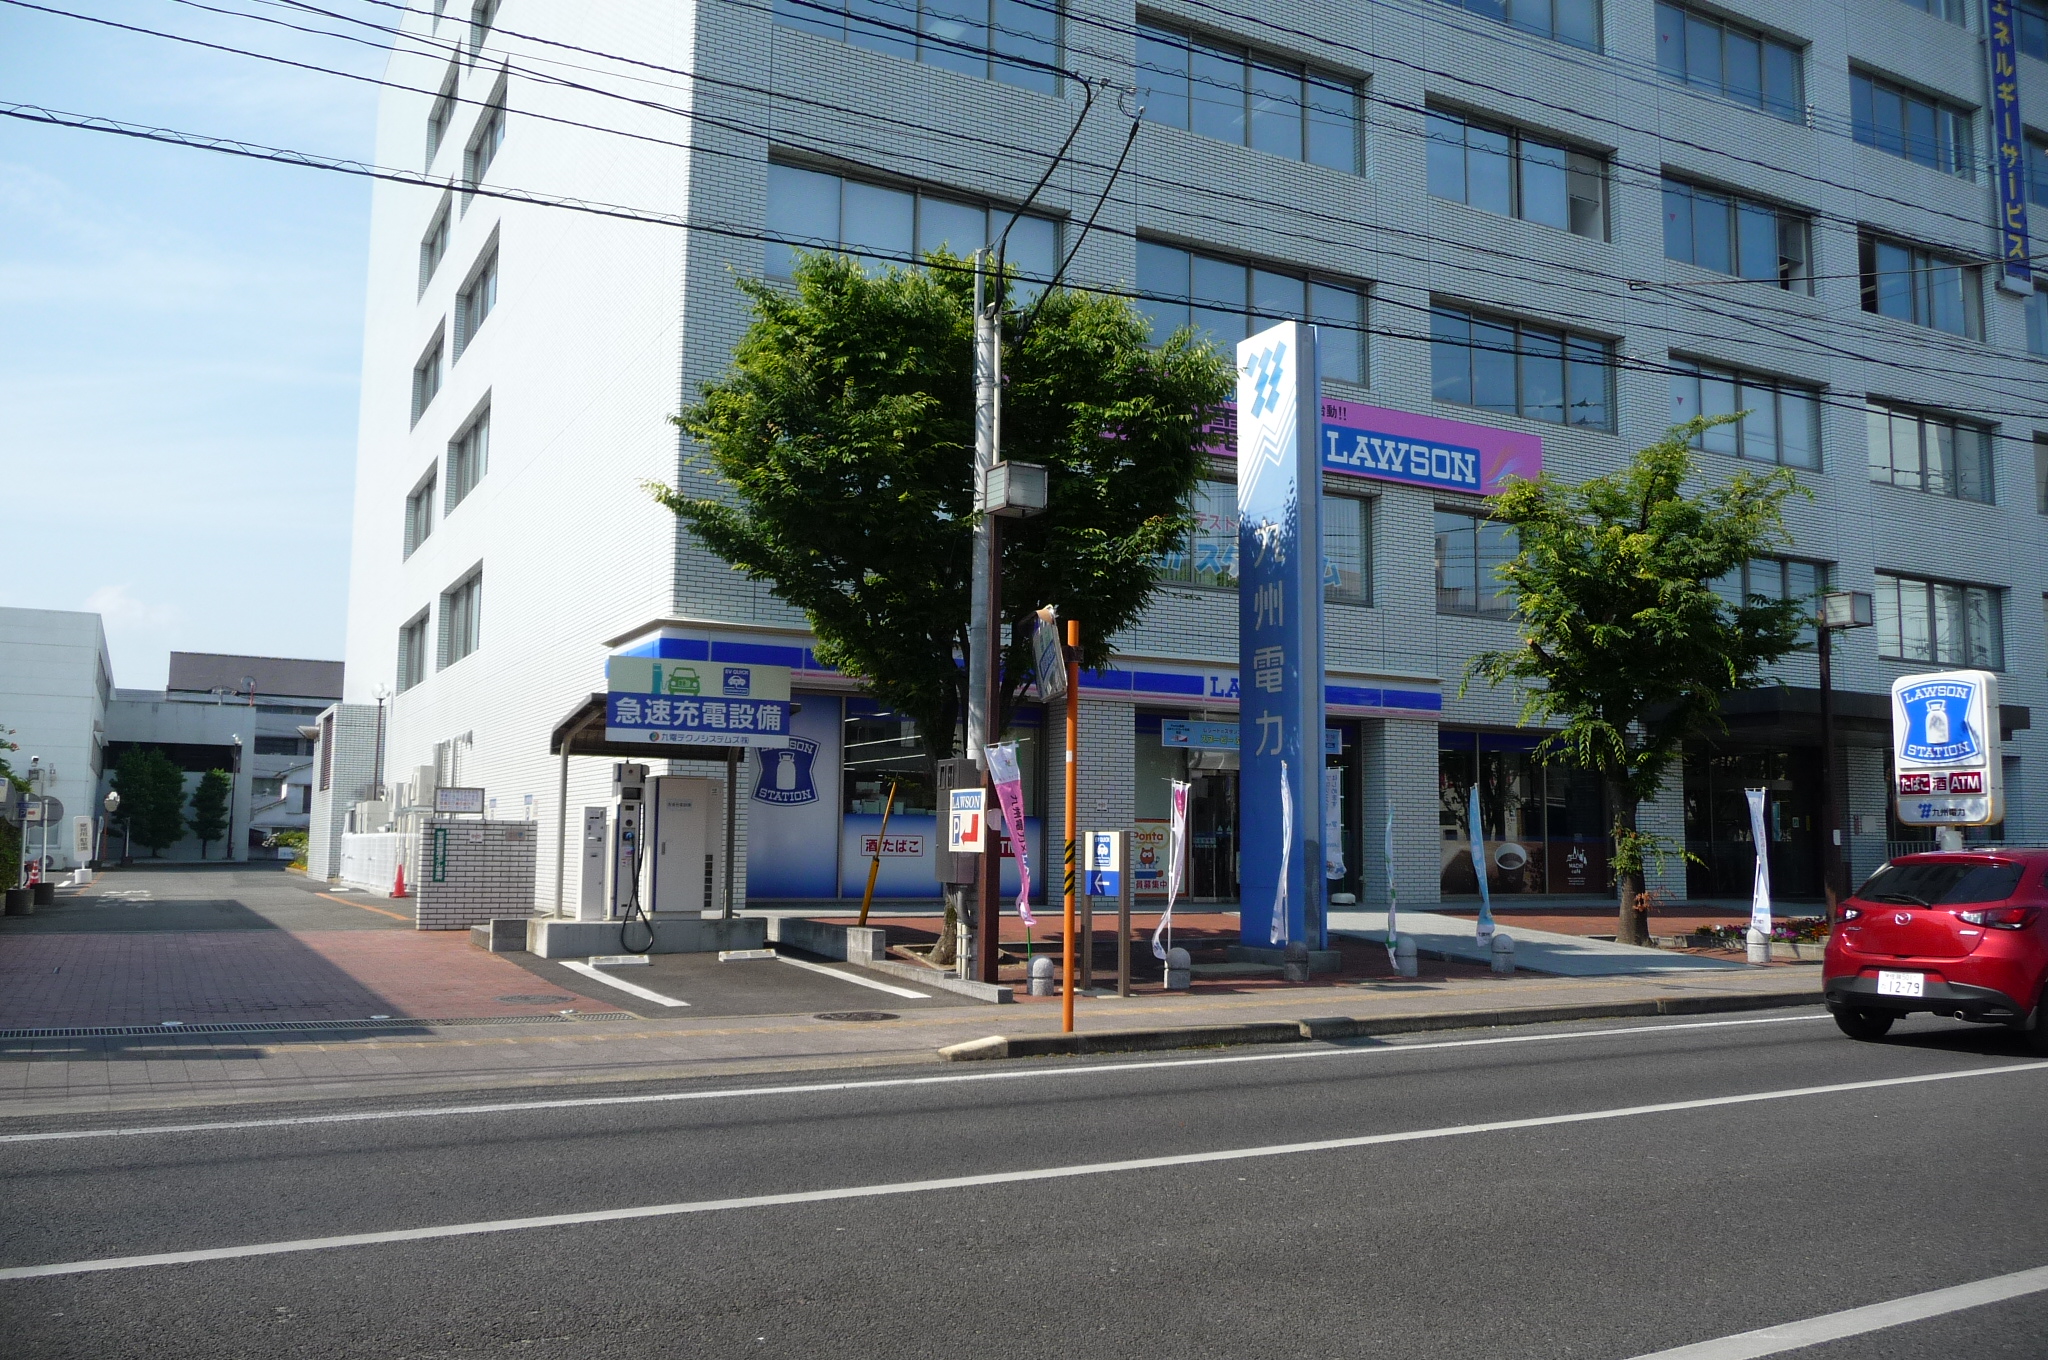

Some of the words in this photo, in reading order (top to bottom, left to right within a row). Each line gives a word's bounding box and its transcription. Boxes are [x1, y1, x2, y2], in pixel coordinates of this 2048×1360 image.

[1327, 430, 1476, 484] LAWSON
[1253, 520, 1284, 757] 九州電力
[1903, 685, 1969, 704] LAWSON
[615, 697, 782, 731] 急速充電設備
[1907, 741, 1971, 758] STATION
[1901, 777, 1930, 793] たばこ
[1932, 777, 1947, 791] 酒
[1951, 775, 1980, 790] ATM
[758, 787, 812, 801] STATION
[952, 795, 981, 809] LAWSON
[1932, 808, 1966, 817] 九州電力
[953, 817, 960, 843] P
